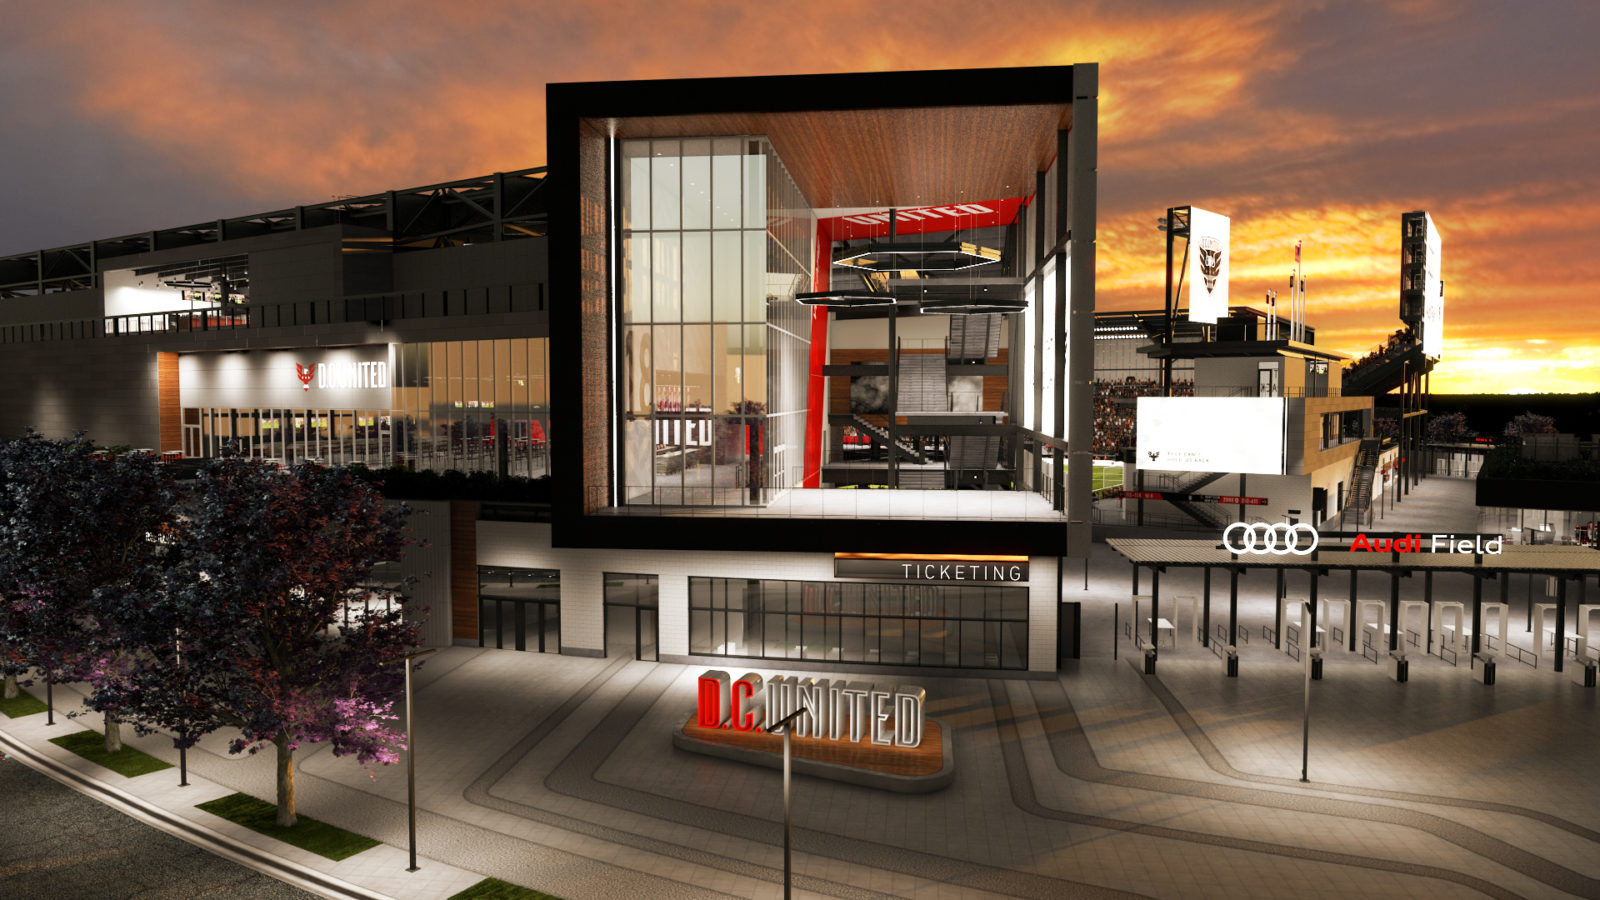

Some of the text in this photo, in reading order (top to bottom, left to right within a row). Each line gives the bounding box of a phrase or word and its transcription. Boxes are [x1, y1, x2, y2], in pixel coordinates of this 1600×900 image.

[842, 203, 994, 225] UNITED
[1350, 533, 1503, 555] Audi Field
[901, 563, 1021, 581] TICKETING
